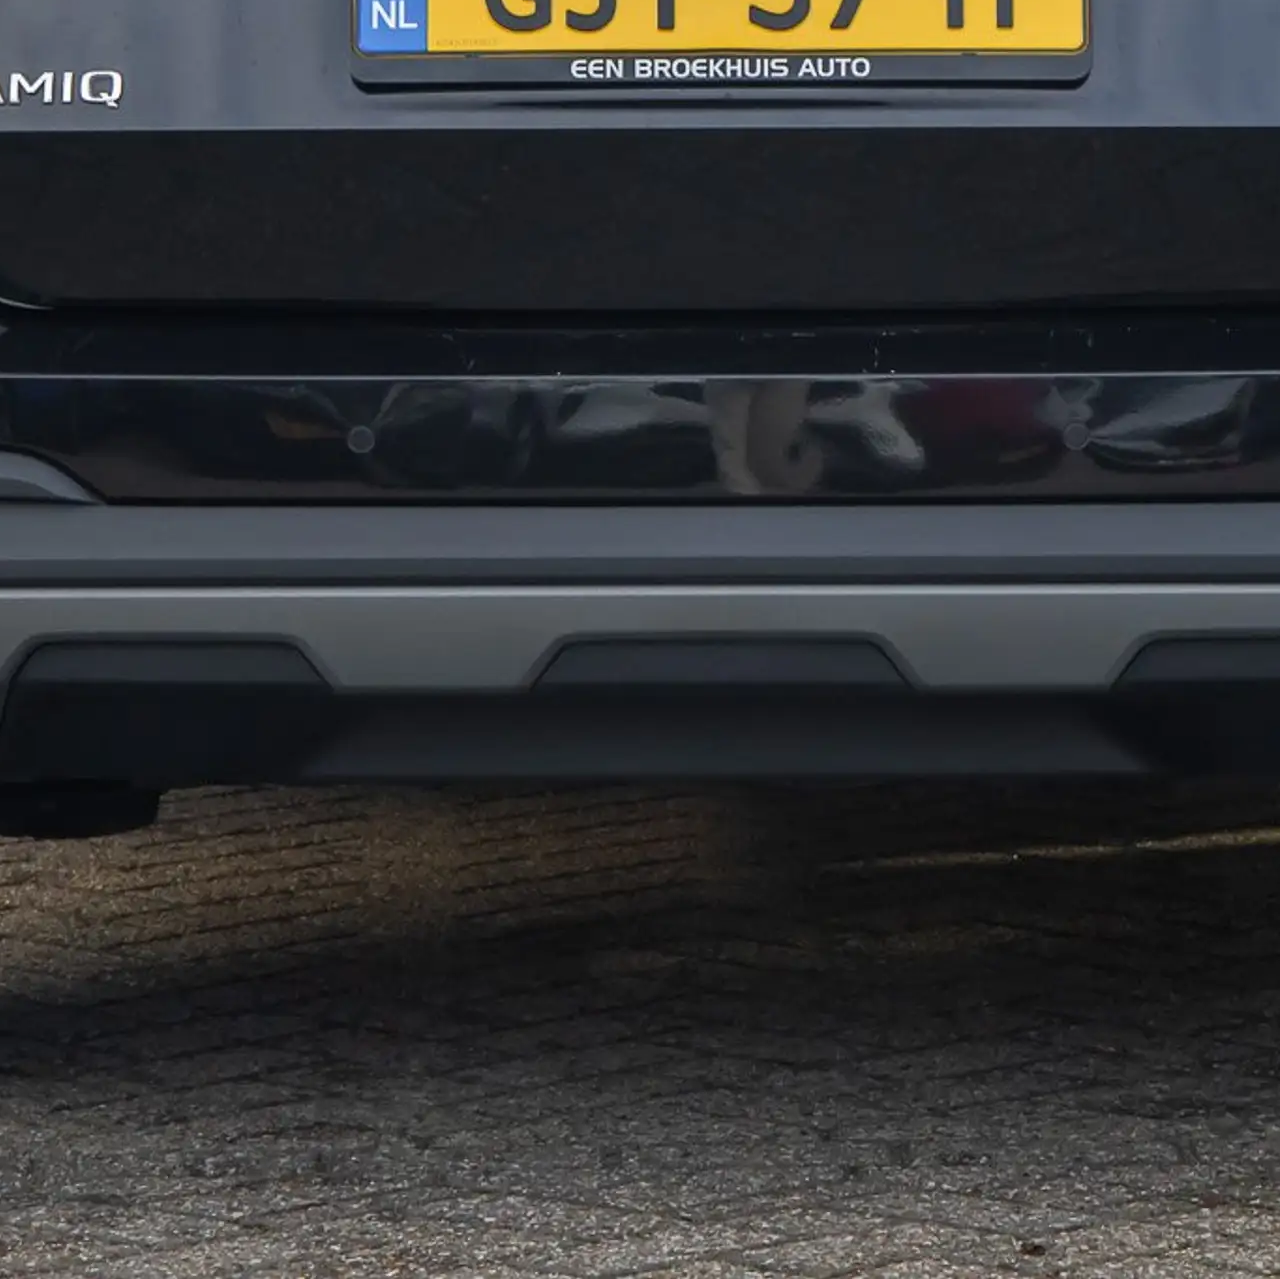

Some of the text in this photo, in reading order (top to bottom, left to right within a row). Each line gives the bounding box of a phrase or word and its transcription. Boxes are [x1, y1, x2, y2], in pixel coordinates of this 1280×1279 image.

[371, 0, 419, 29] NL
[570, 57, 871, 79] EEN BROEKHUIS AUTO
